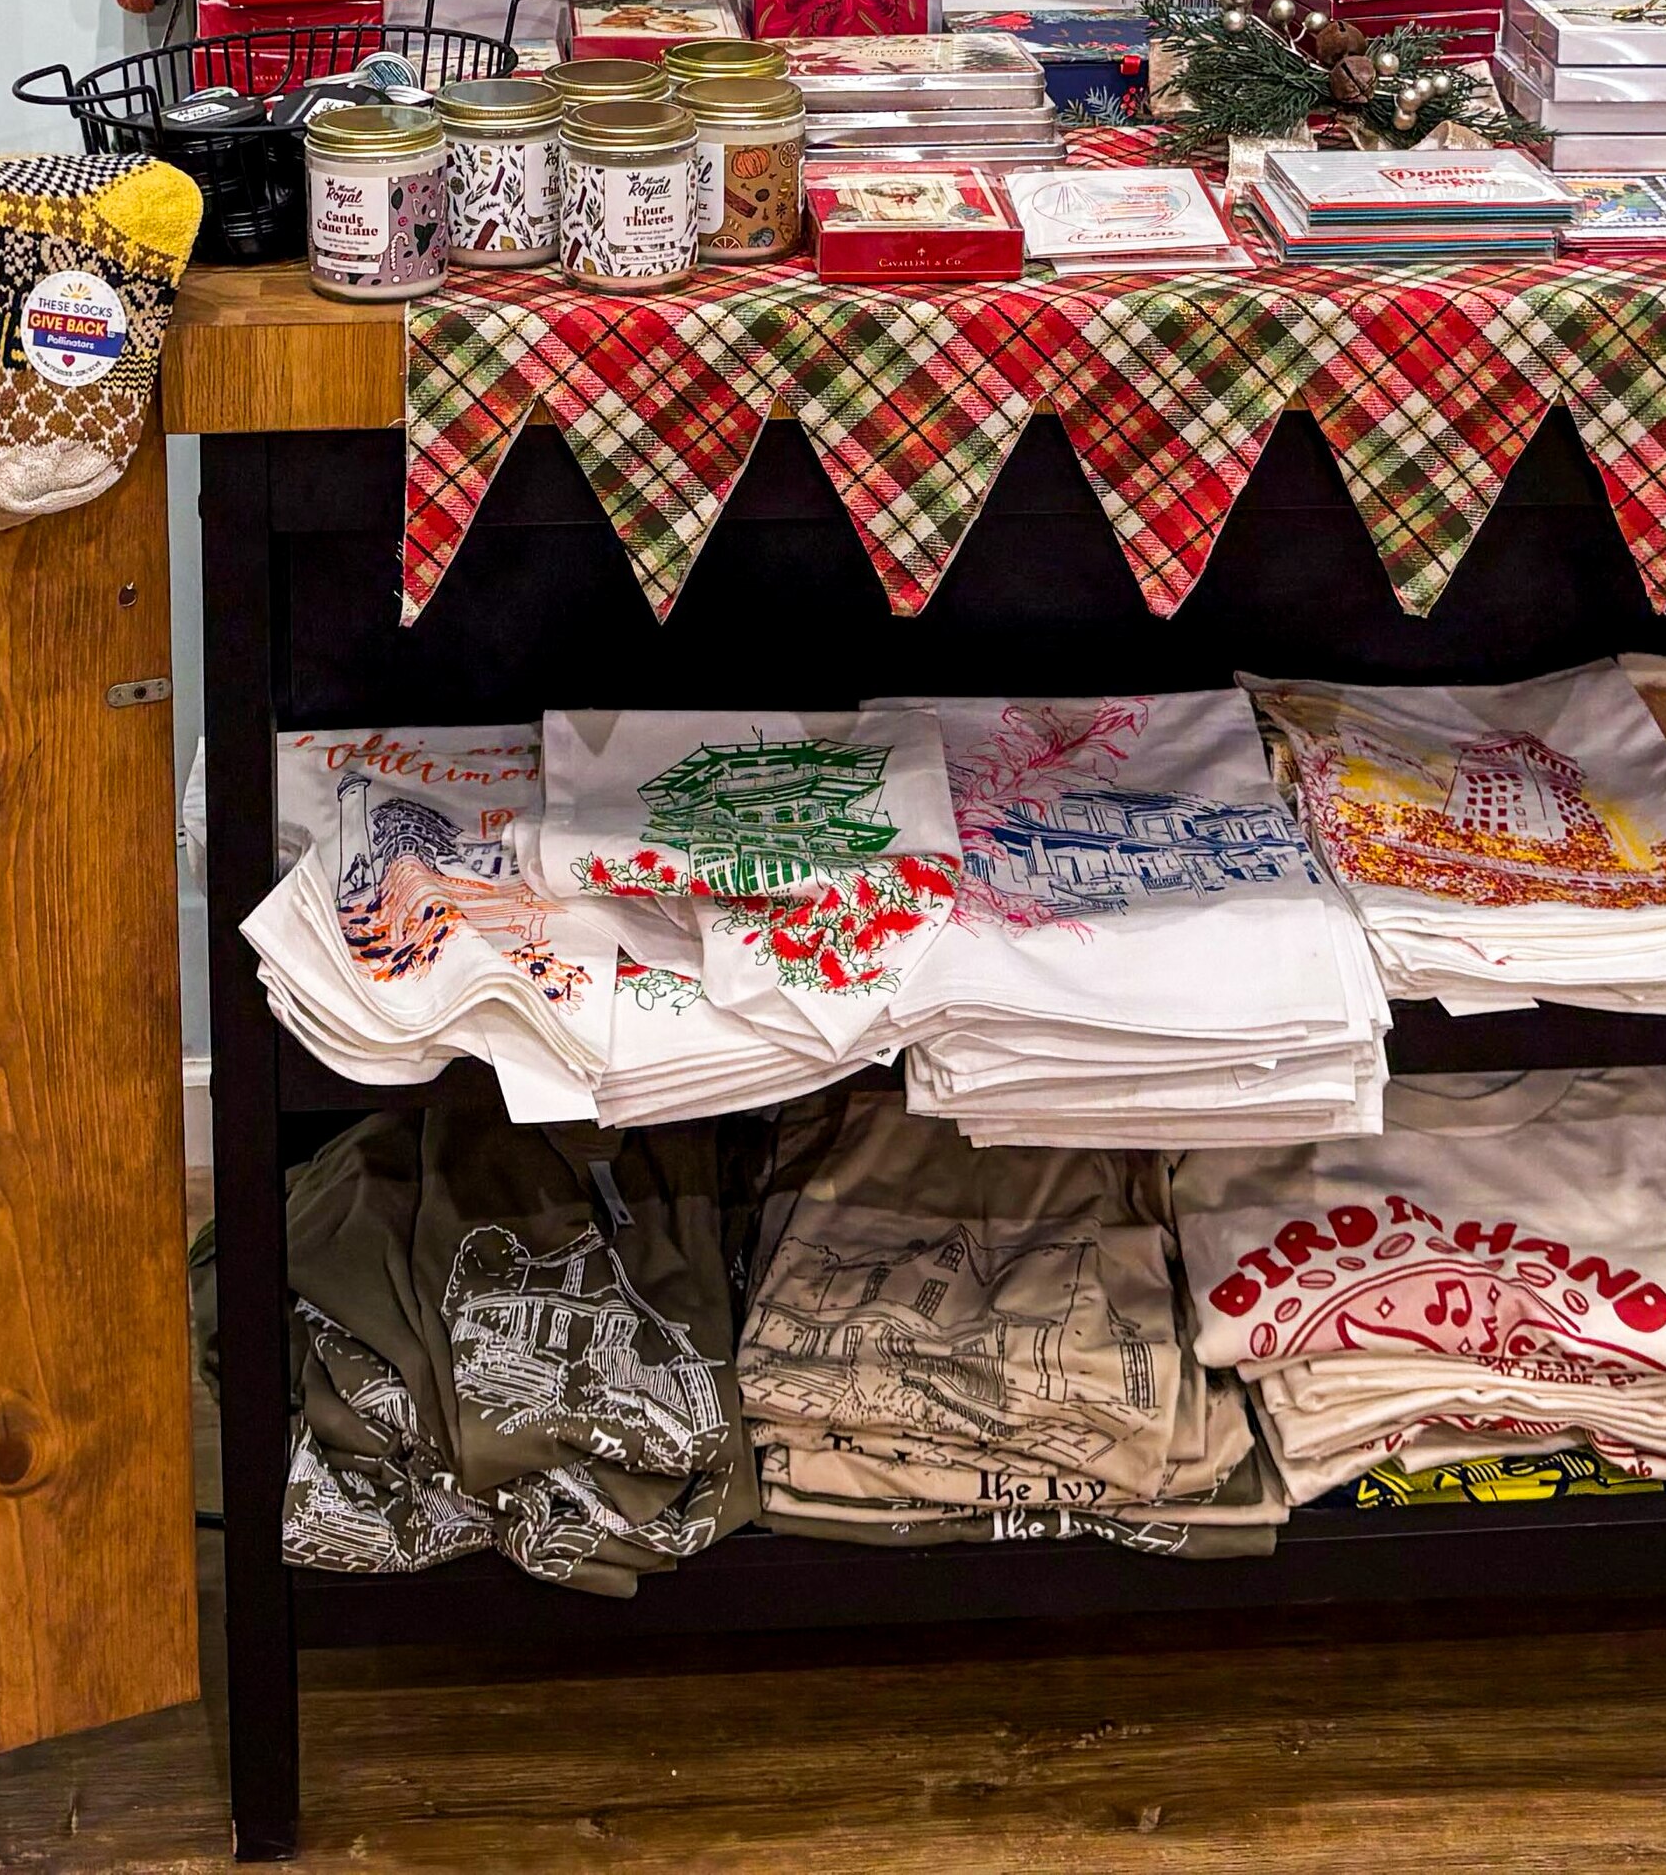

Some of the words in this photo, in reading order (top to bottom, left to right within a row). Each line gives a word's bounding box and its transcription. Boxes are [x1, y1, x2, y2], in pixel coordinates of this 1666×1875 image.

[326, 187, 363, 208] Royal
[628, 177, 671, 203] Royal
[326, 211, 364, 227] Candy
[634, 205, 665, 215] Four
[317, 219, 341, 234] Cane
[345, 225, 378, 236] Lane
[623, 215, 674, 227] Thieves
[879, 257, 930, 269] CAVALLINI
[935, 259, 942, 267] &
[38, 298, 70, 312] THESE
[74, 303, 112, 318] SOCKS
[30, 313, 63, 330] GIVE
[66, 319, 105, 336] BACK
[47, 334, 94, 349] Pollinators
[1208, 1205, 1379, 1318] BIRD
[1384, 1195, 1444, 1233] IN
[977, 1470, 1032, 1505] The
[1044, 1476, 1107, 1506] Ivy
[991, 1509, 1046, 1542] The
